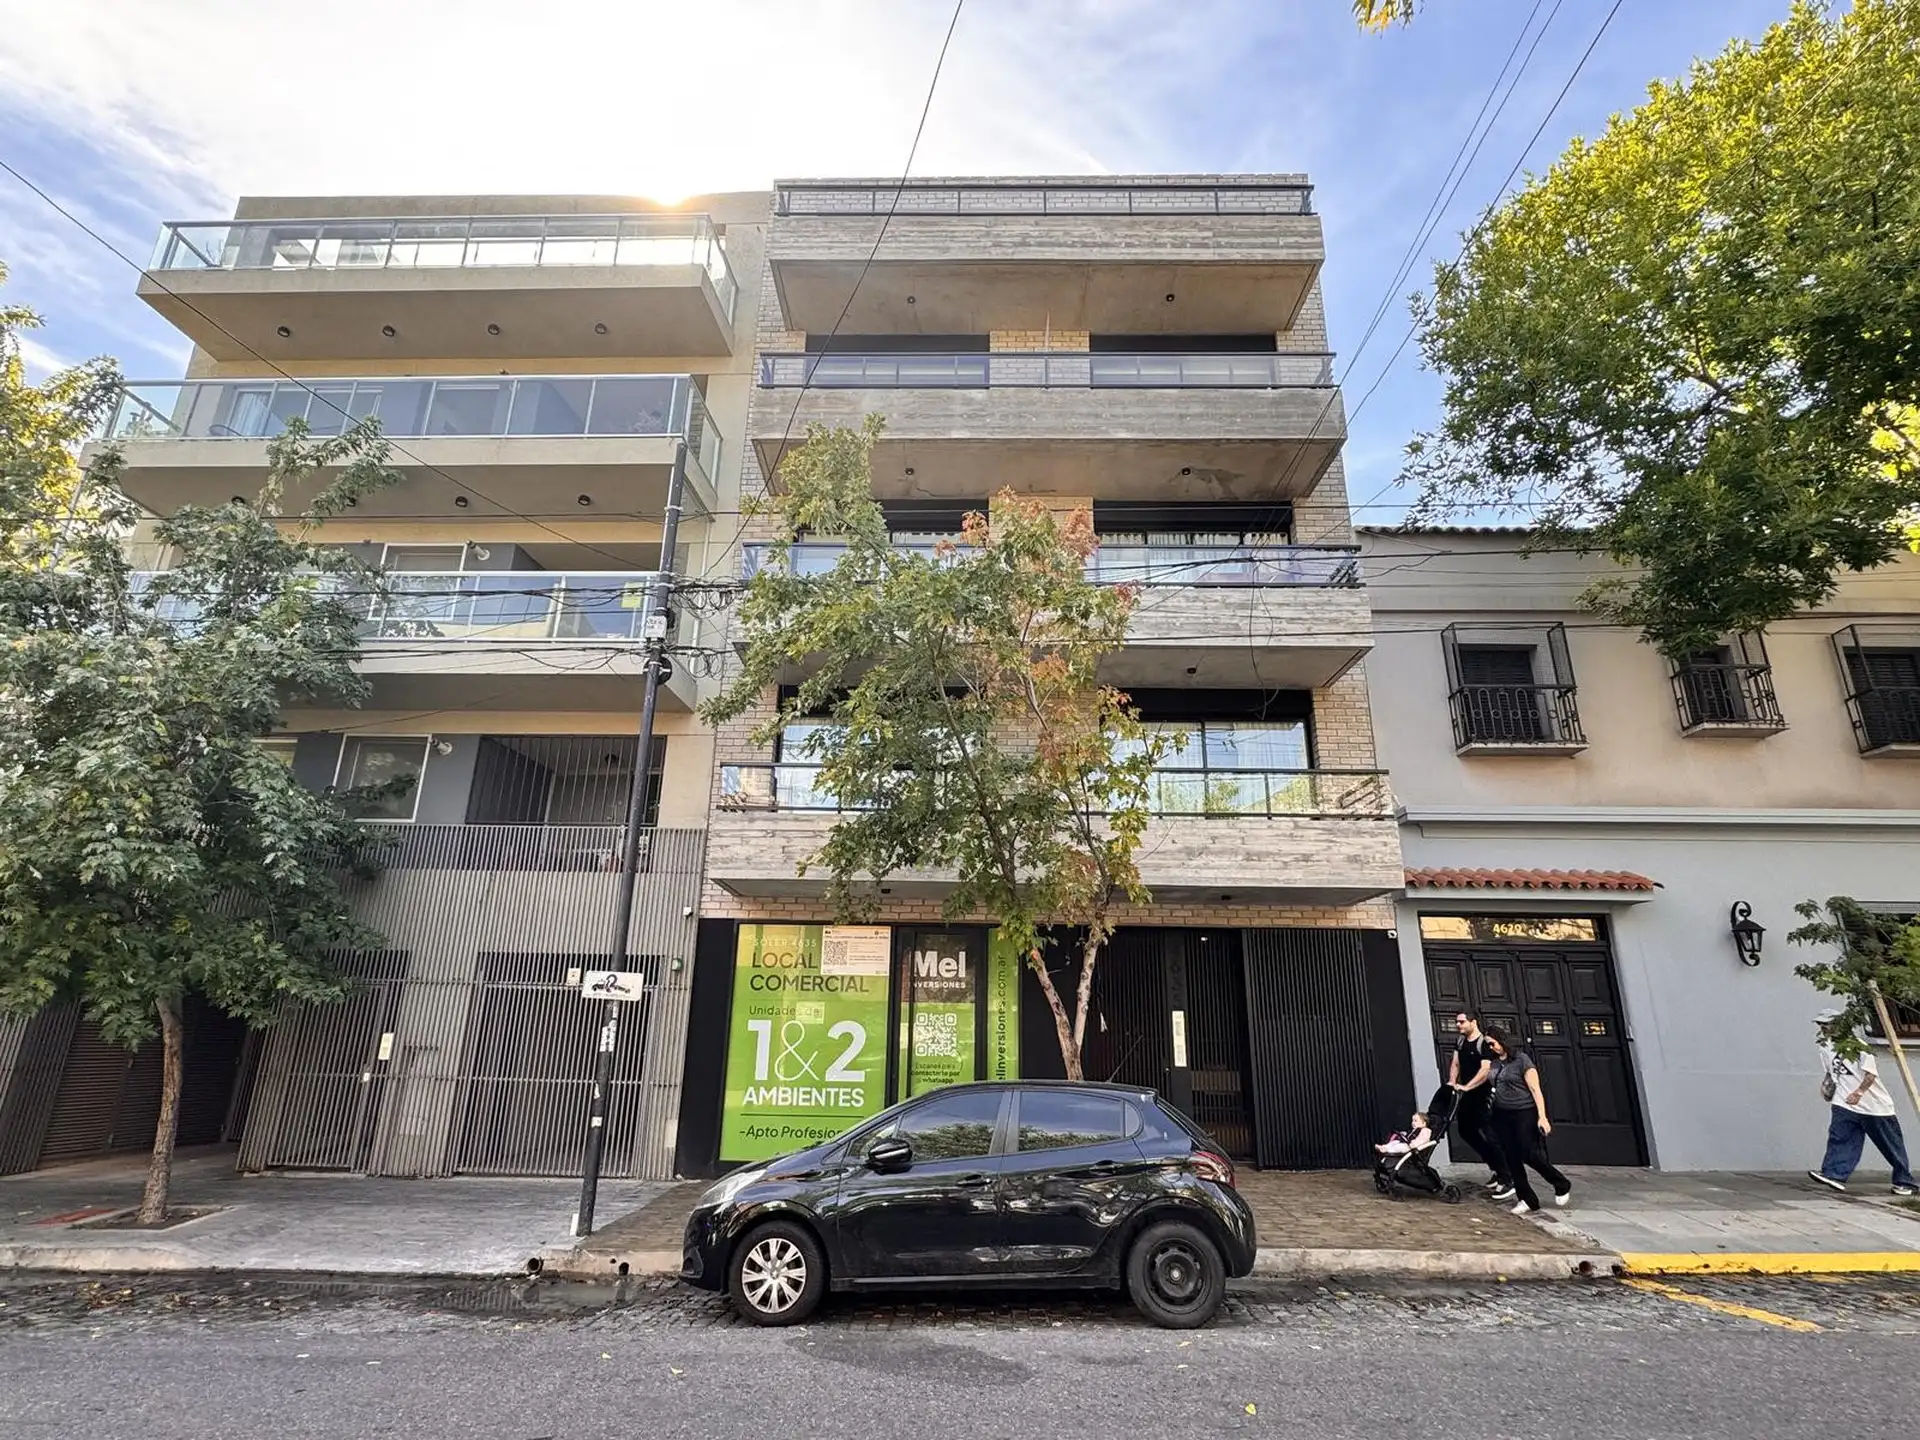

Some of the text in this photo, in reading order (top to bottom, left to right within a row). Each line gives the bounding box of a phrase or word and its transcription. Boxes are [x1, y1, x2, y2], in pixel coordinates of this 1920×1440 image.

[752, 952, 818, 968] LOCAL
[914, 950, 966, 978] Mel
[750, 974, 869, 993] COMERCIAL
[914, 981, 966, 989] NVERSIONES
[749, 1005, 801, 1017] Unidade
[743, 1086, 864, 1107] AMBIENTES
